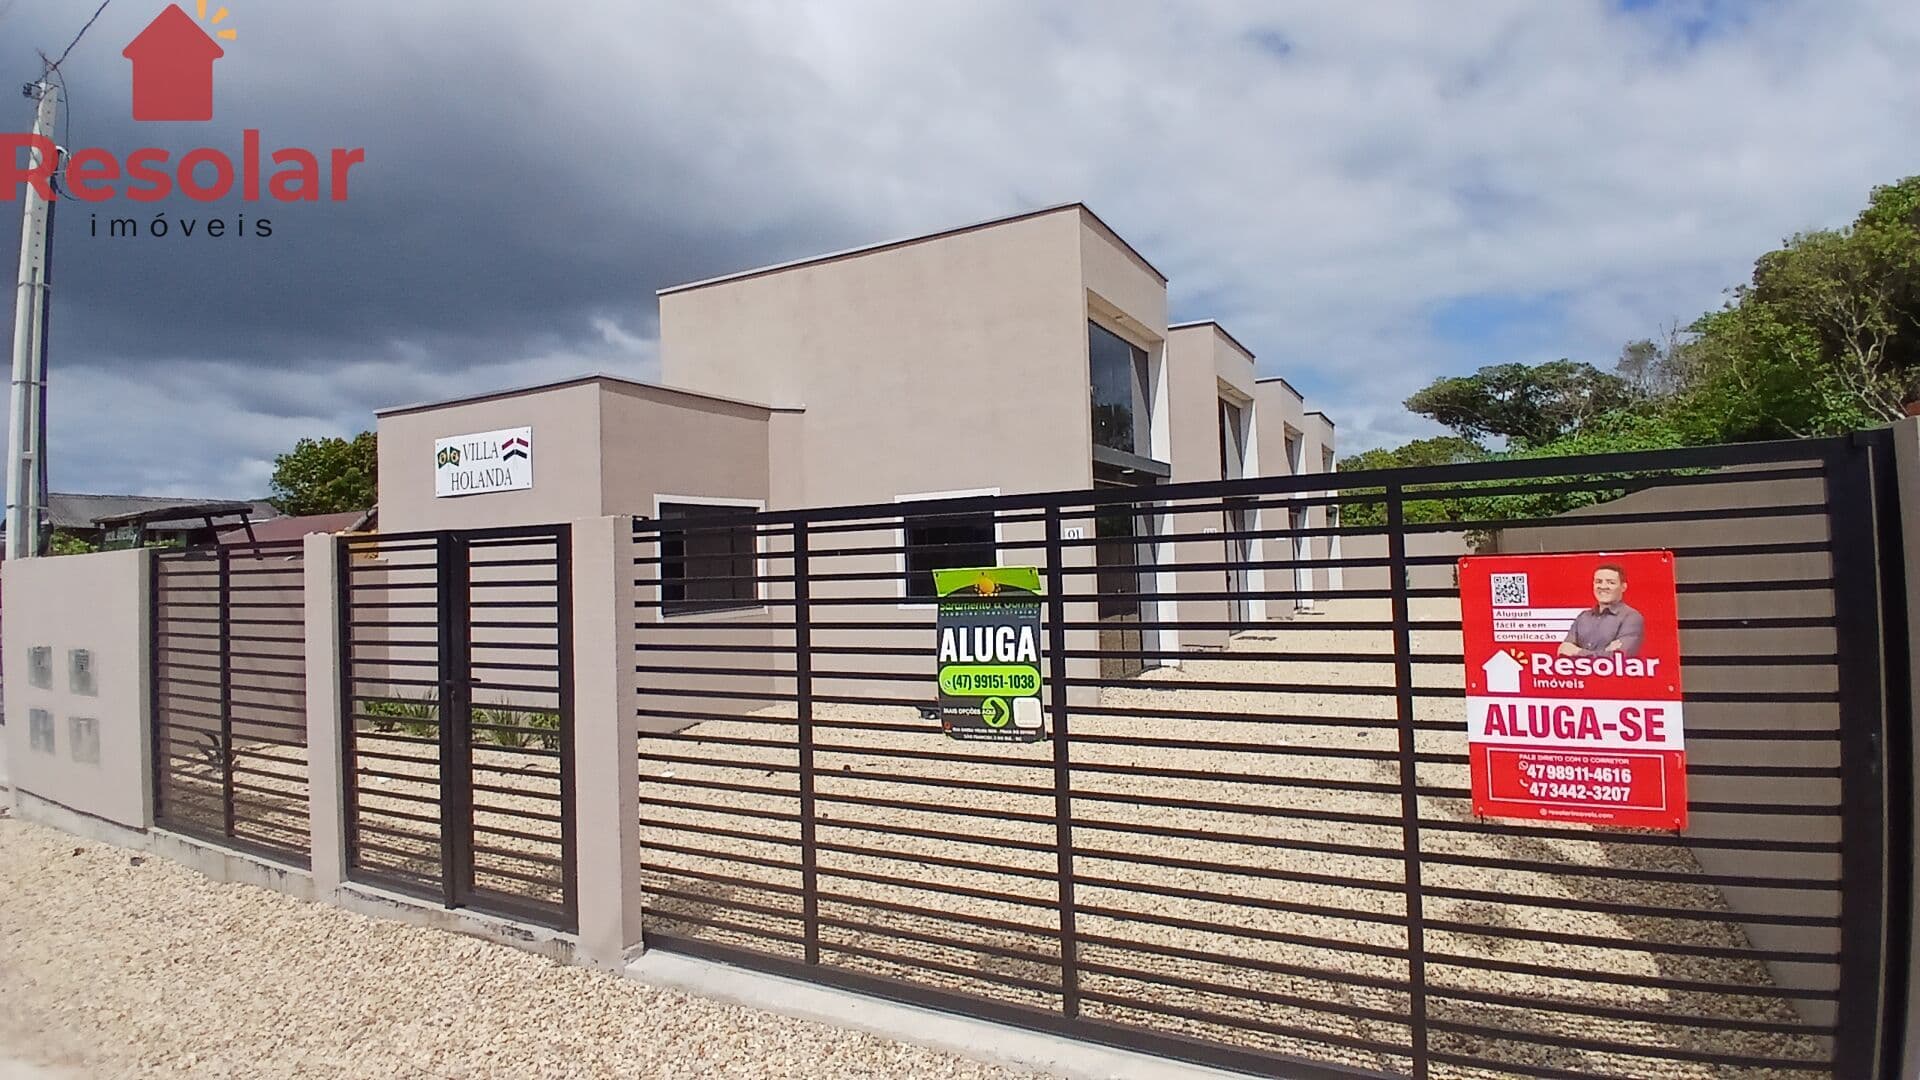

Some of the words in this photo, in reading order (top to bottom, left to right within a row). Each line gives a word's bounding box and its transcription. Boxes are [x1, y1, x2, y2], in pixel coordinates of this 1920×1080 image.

[463, 441, 499, 461] VILLA
[451, 468, 512, 491] HOLANDA
[940, 626, 1037, 662] ALUGA
[1531, 652, 1660, 677] Resolar
[952, 674, 972, 691] (47)
[974, 674, 1035, 689] 99151-1038
[1533, 677, 1585, 689] imóveis
[1484, 703, 1666, 742] ALUGA-SE
[1565, 755, 1581, 763] COM
[1546, 765, 1632, 784] 98911-4616
[1530, 782, 1547, 797] 47
[1549, 783, 1631, 801] 3442-3207
